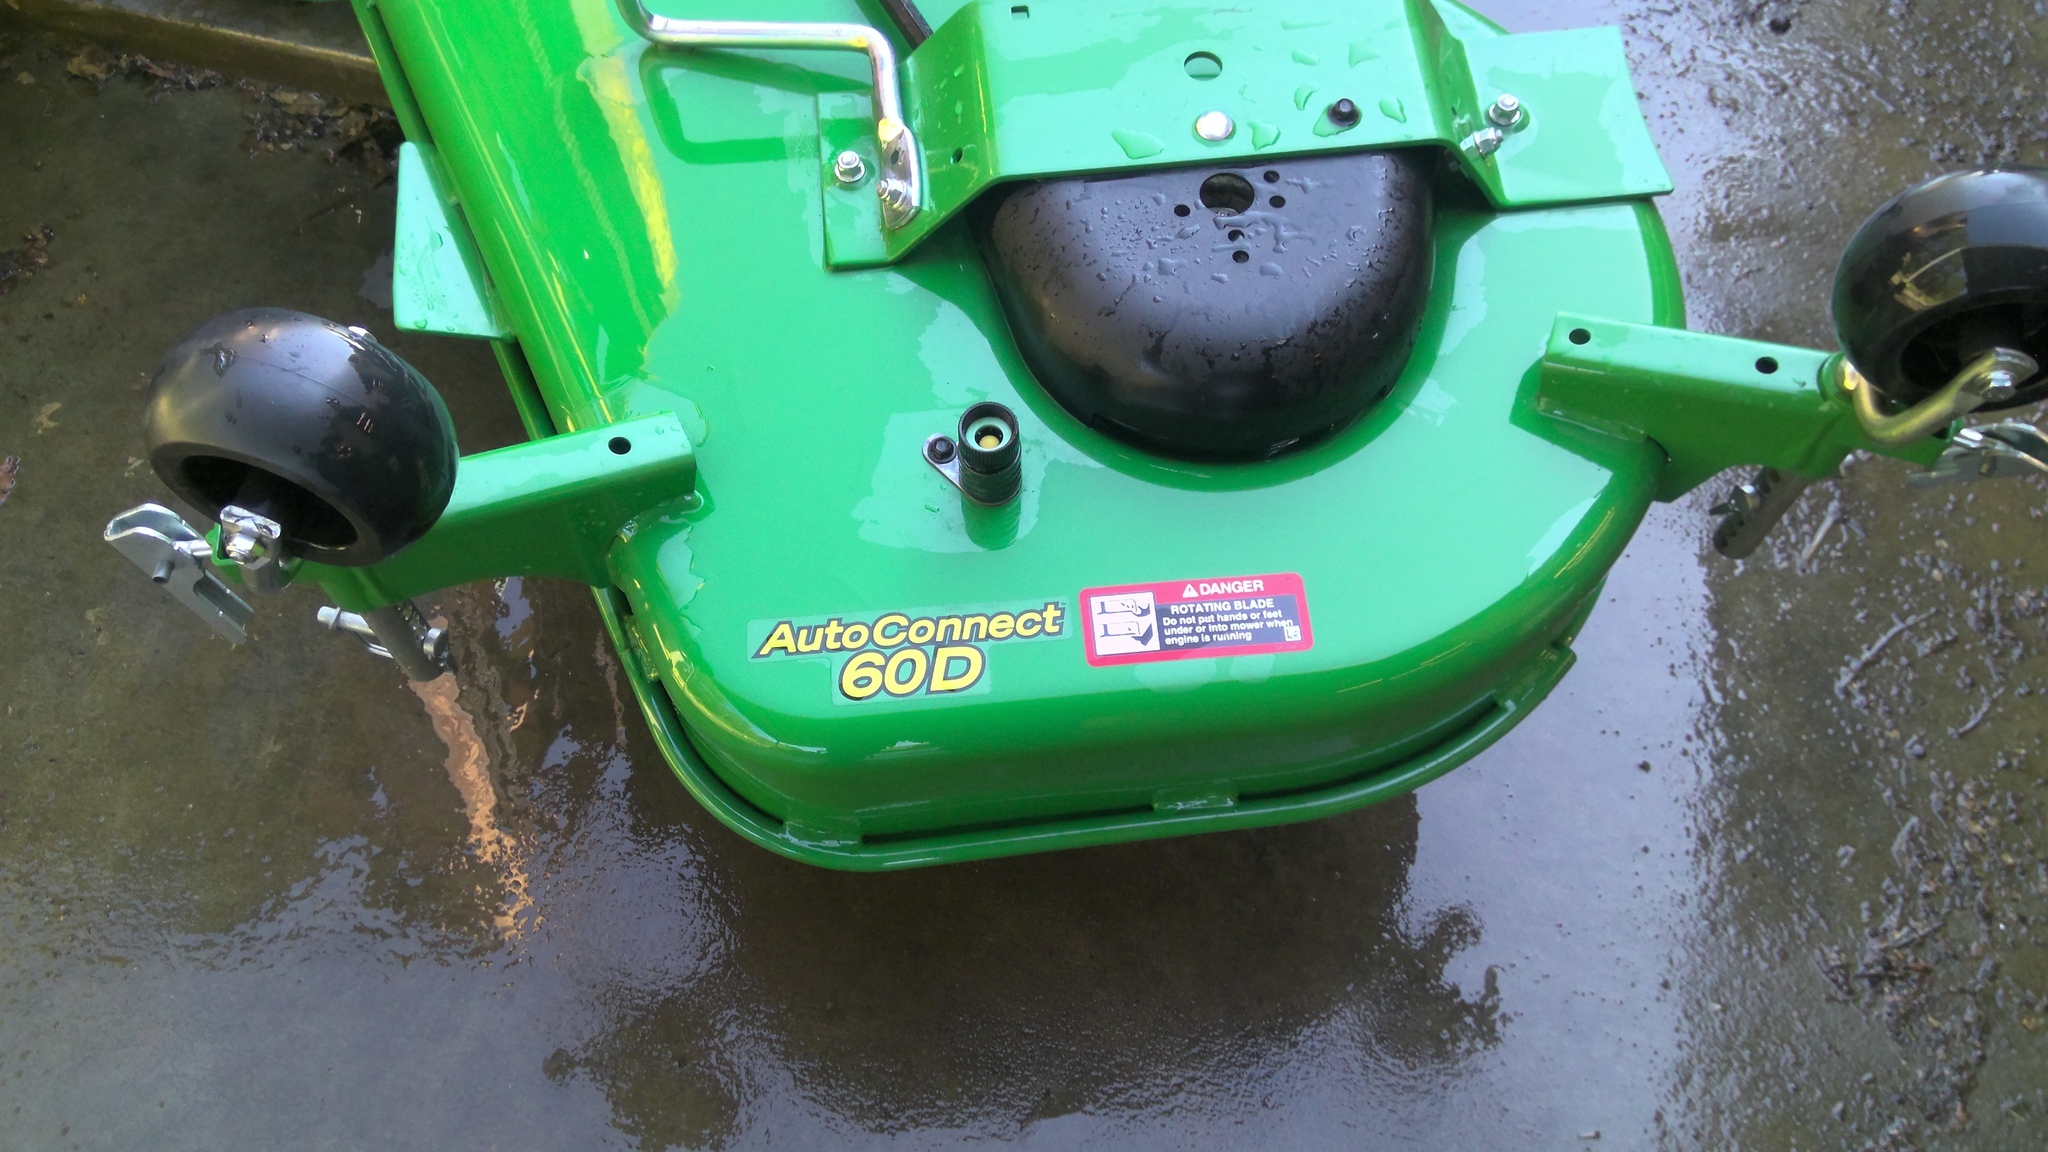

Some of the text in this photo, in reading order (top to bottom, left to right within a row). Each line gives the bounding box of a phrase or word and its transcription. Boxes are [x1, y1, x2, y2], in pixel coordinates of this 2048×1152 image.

[1199, 580, 1264, 596] DANGER
[1171, 598, 1274, 615] ROTATING BLADE
[1163, 609, 1283, 626] Do not put hands or feet
[752, 601, 1066, 659] AutoConnect
[1164, 618, 1294, 636] under or into mower when
[1165, 629, 1252, 647] engine is running
[838, 645, 986, 701] 60D
